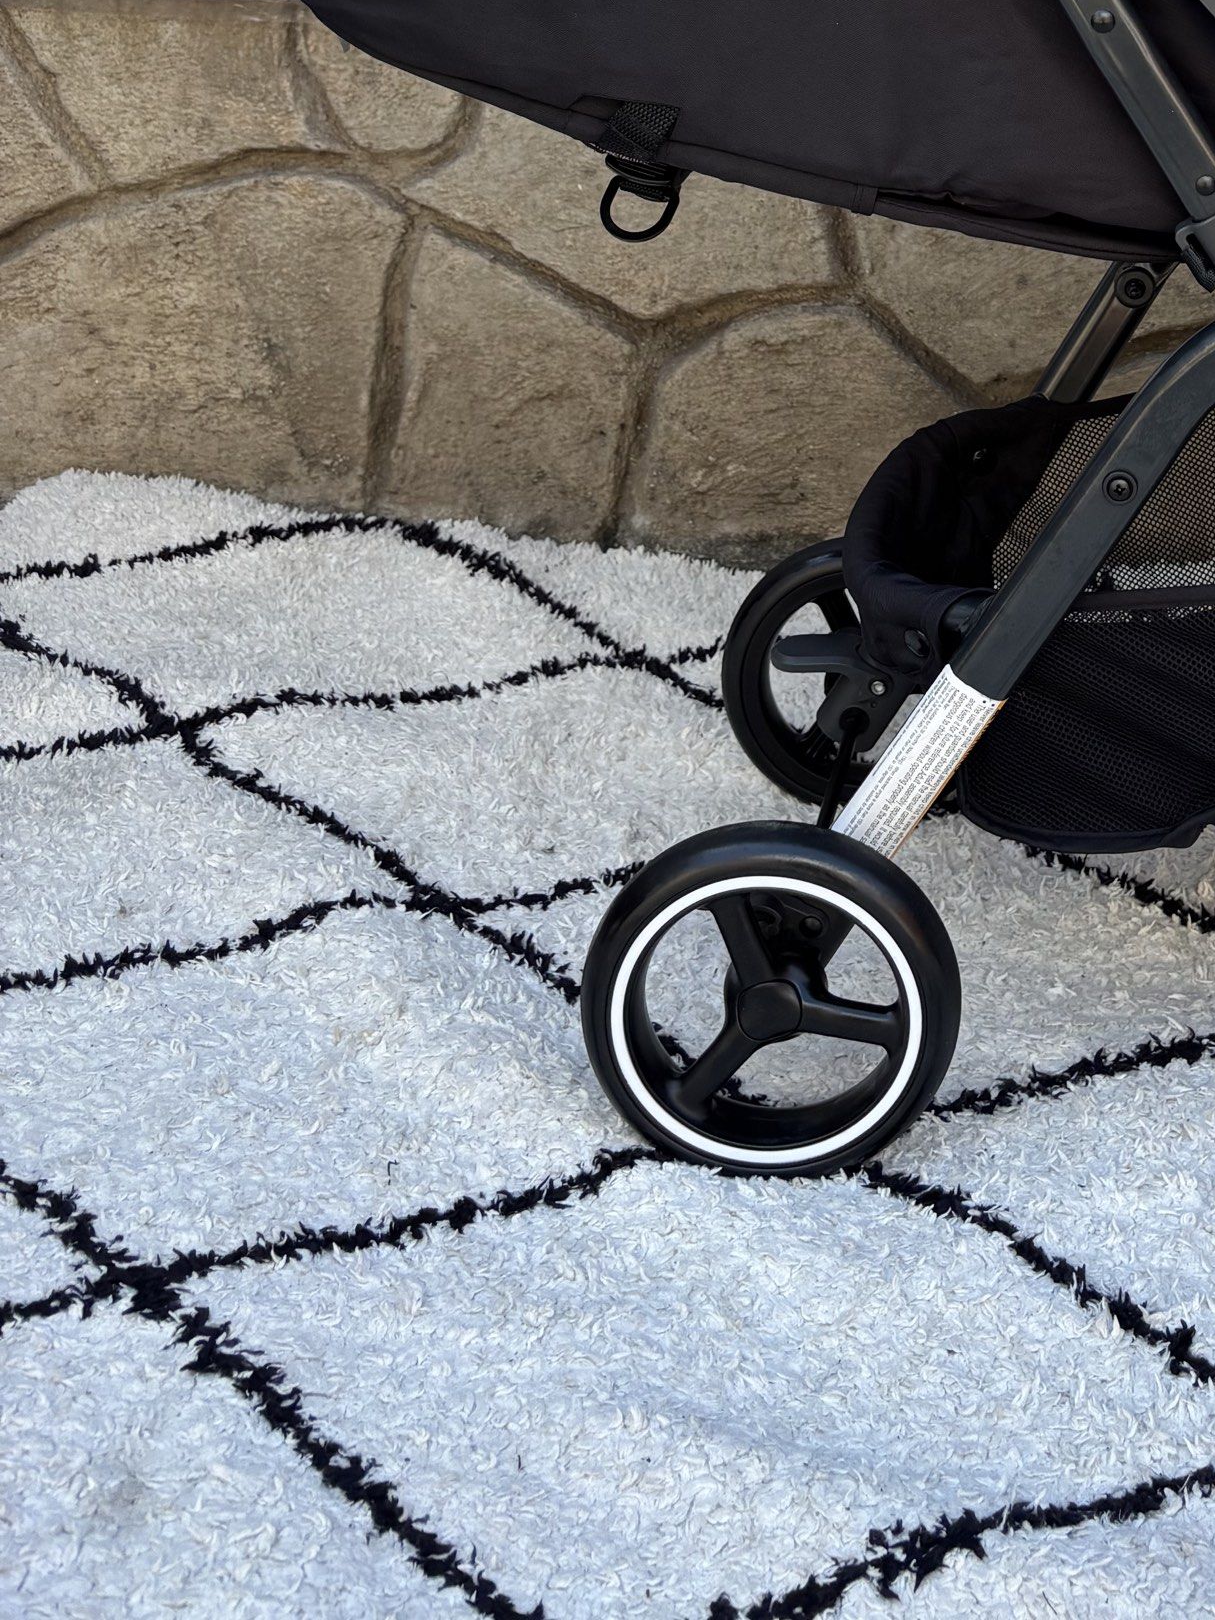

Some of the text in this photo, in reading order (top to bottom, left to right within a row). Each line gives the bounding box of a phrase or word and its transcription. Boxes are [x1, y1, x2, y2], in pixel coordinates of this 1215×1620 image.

[928, 725, 944, 745] children
[958, 725, 968, 736] and
[932, 756, 946, 774] should
